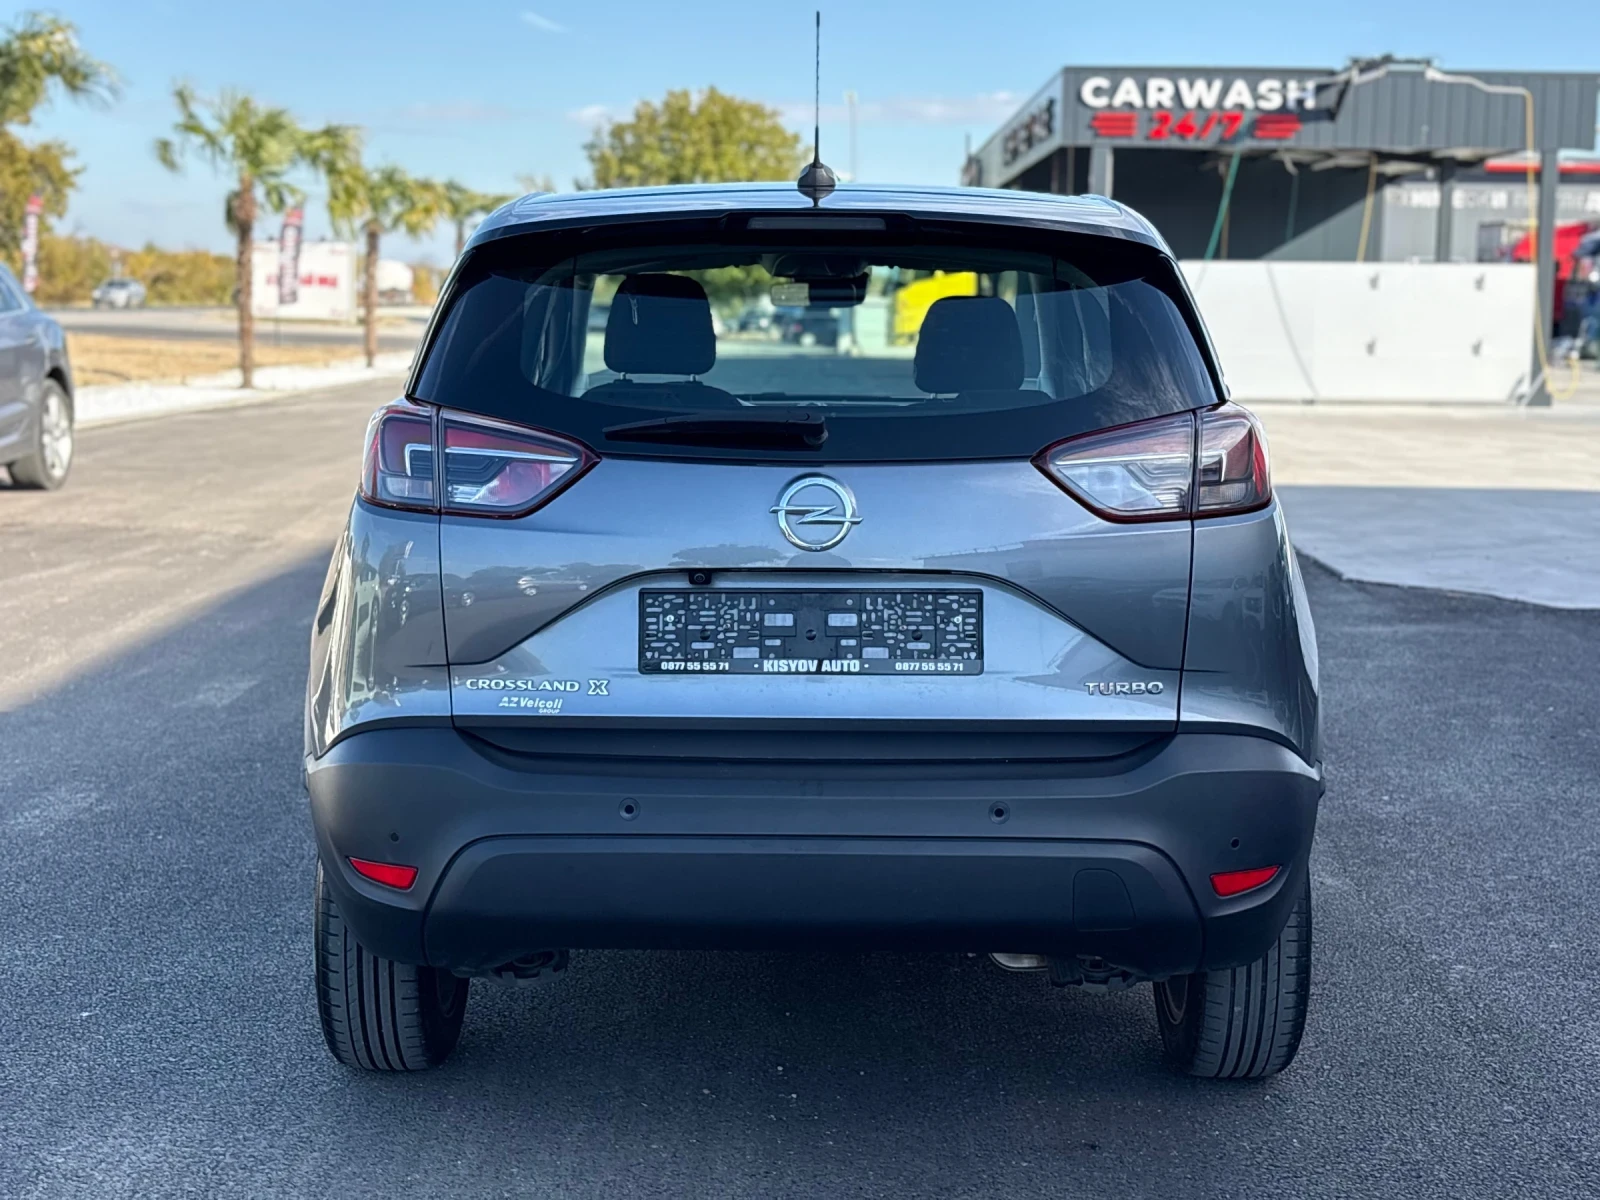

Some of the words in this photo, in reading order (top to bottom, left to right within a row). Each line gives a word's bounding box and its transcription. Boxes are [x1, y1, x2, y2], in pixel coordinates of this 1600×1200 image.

[1080, 76, 1317, 111] CARWASH
[1148, 111, 1245, 140] 24/7
[661, 661, 685, 671] 0877
[687, 661, 700, 671] 55
[702, 661, 716, 671] 55
[718, 661, 729, 671] 71
[763, 659, 818, 673] KISYOV
[821, 659, 860, 673] AUTO
[895, 662, 919, 671] 0877
[921, 662, 935, 671] 55
[937, 662, 951, 671] 55
[953, 662, 964, 671] 71
[465, 678, 580, 692] CROSSLAND
[587, 679, 610, 696] X
[1084, 681, 1164, 695] TURBO
